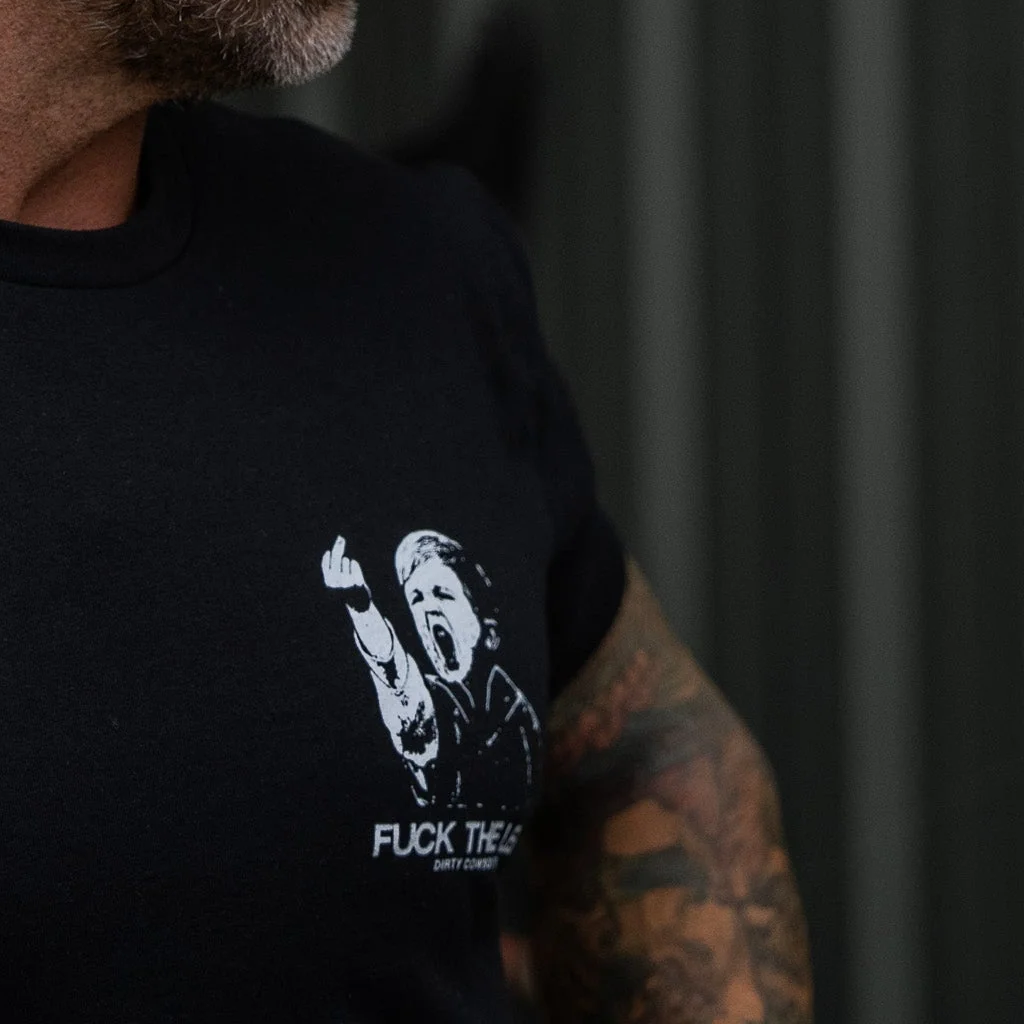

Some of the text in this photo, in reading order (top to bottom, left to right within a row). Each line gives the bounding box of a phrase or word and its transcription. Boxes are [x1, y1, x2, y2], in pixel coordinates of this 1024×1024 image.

[372, 821, 456, 857] FUCK
[465, 820, 504, 854] THE
[433, 857, 462, 872] DIRTY
